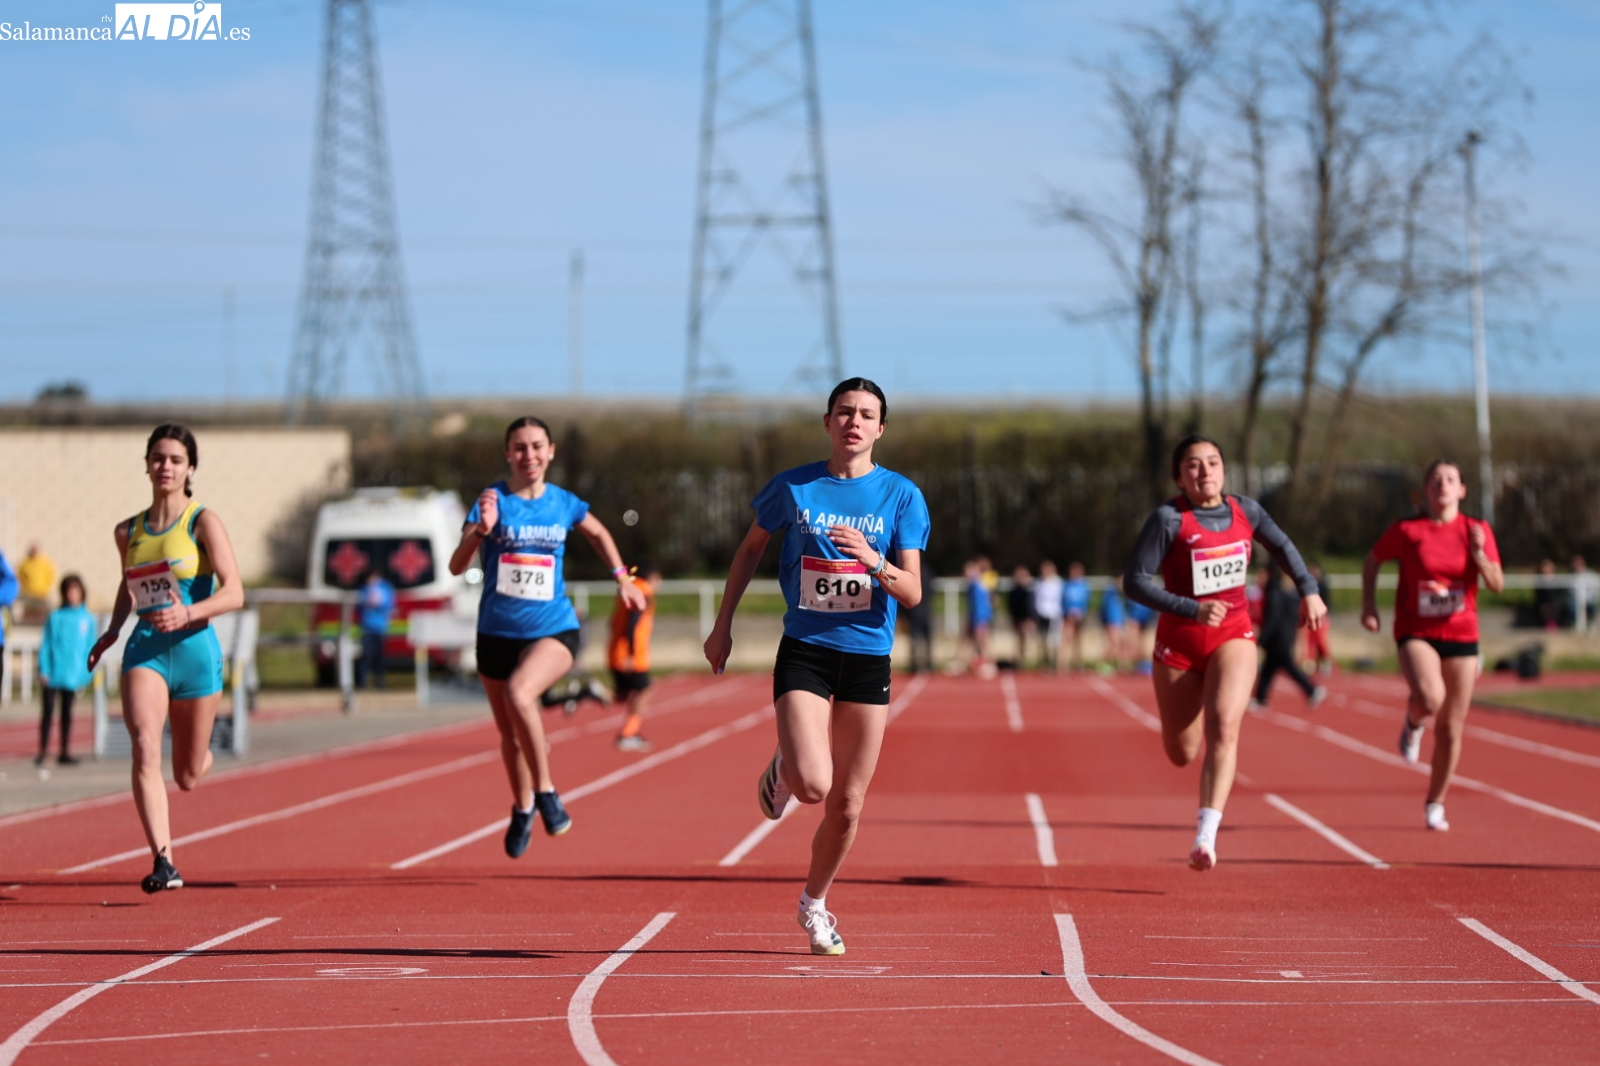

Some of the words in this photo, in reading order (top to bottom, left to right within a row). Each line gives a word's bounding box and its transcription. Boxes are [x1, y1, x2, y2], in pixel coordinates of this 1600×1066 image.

[796, 506, 810, 524] LA
[815, 512, 884, 535] ARMUÑA
[800, 525, 821, 535] CLUB
[511, 569, 545, 585] 378
[1202, 560, 1244, 579] 1022
[815, 578, 860, 597] 610
